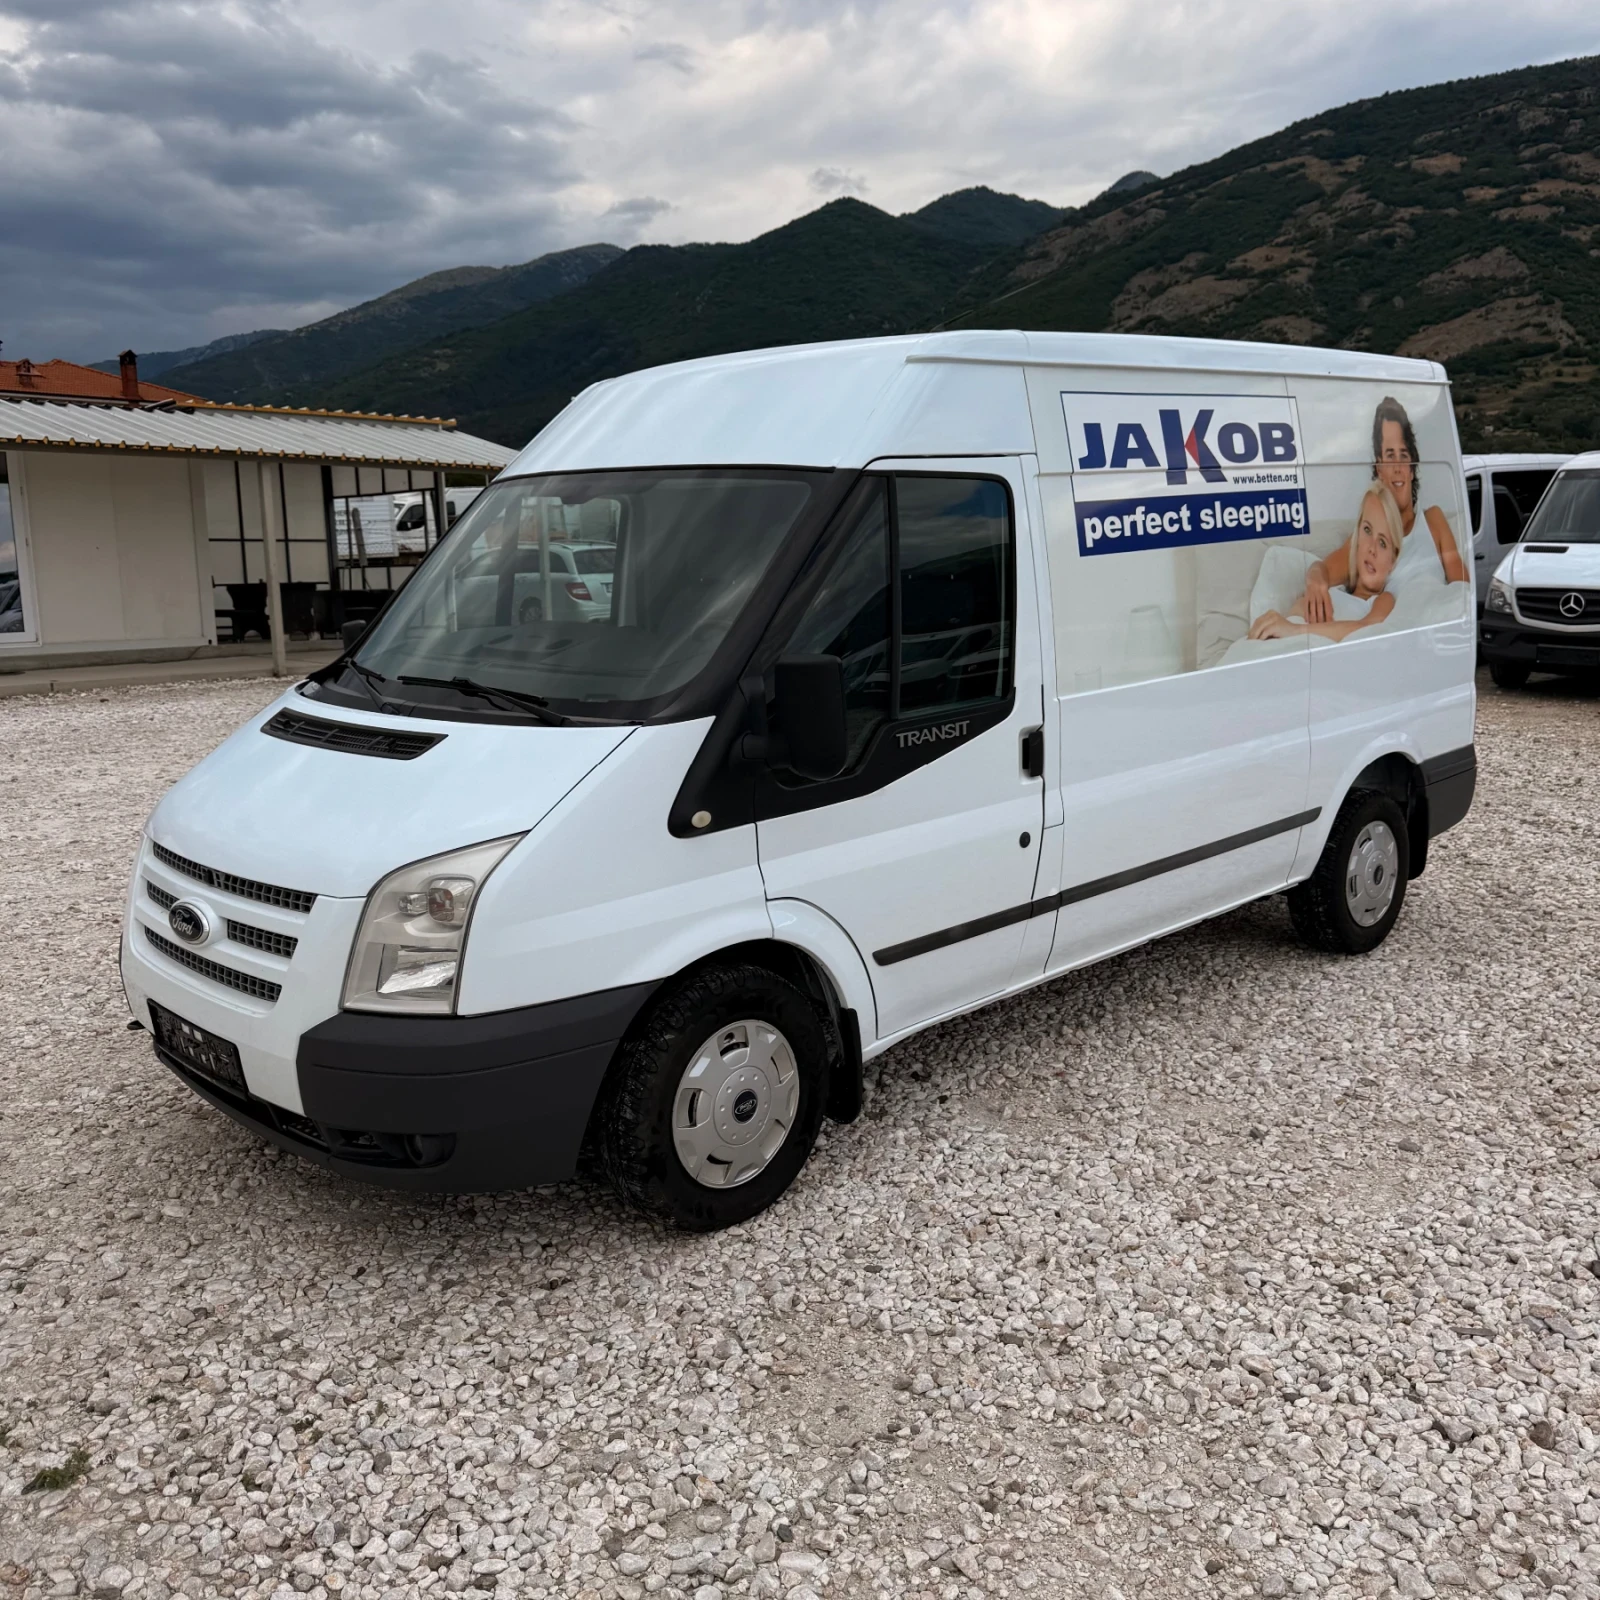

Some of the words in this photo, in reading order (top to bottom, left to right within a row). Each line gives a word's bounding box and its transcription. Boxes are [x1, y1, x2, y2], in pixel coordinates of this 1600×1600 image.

[1078, 409, 1297, 485] JAKOB
[1232, 473, 1298, 485] www.betten.org
[1084, 504, 1191, 547] perfect
[1200, 498, 1304, 531] sleeping
[895, 720, 970, 748] TRANSIT
[172, 909, 195, 935] Ford
